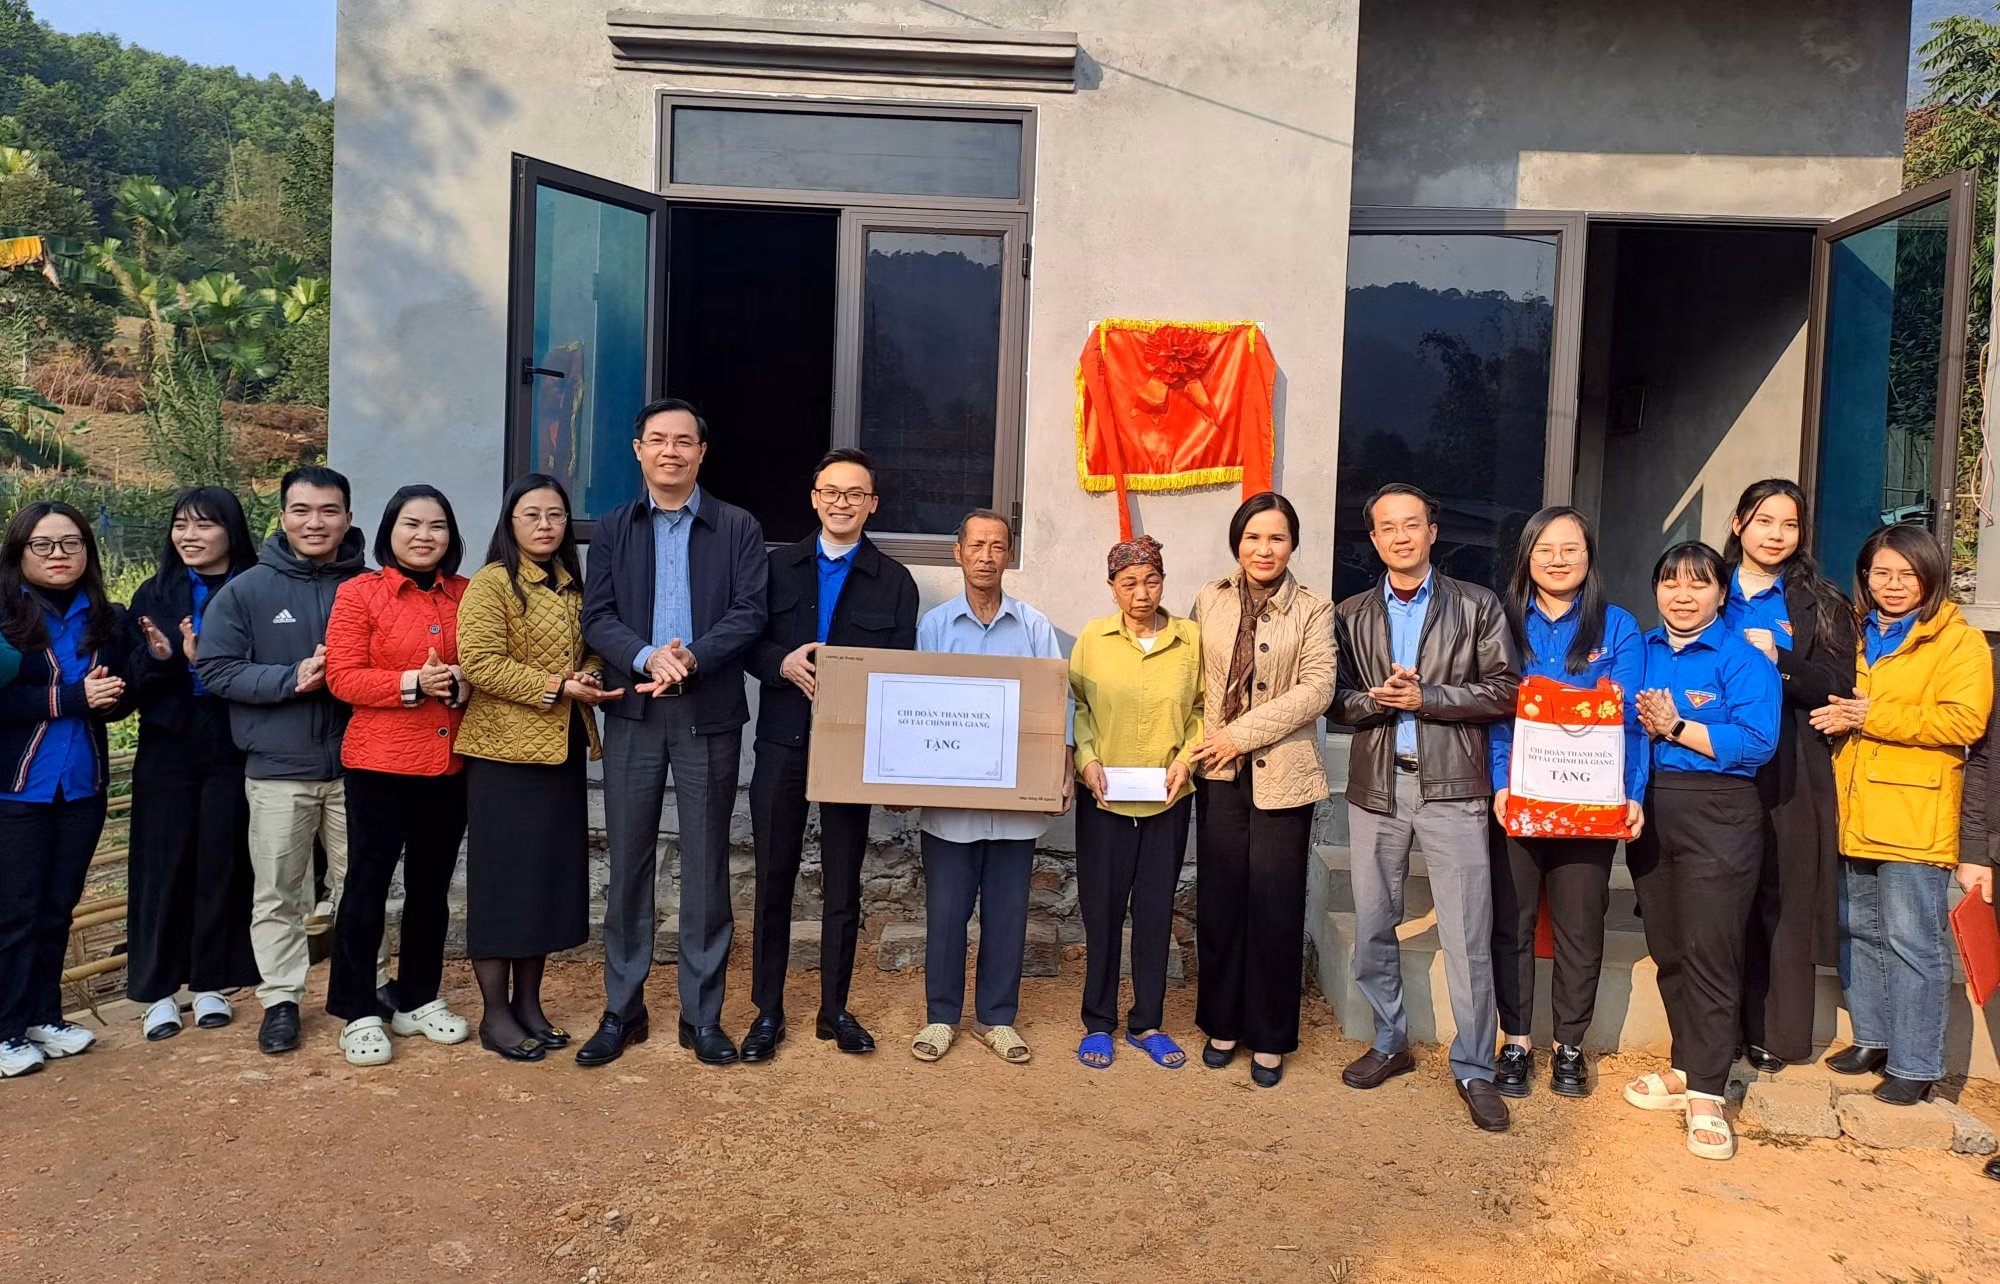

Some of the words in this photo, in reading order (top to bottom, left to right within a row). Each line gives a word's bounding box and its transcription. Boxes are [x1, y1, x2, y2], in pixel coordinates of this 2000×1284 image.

[897, 709, 913, 717] CHI
[940, 711, 969, 719] THANH
[1550, 769, 1591, 783] TẶNG
